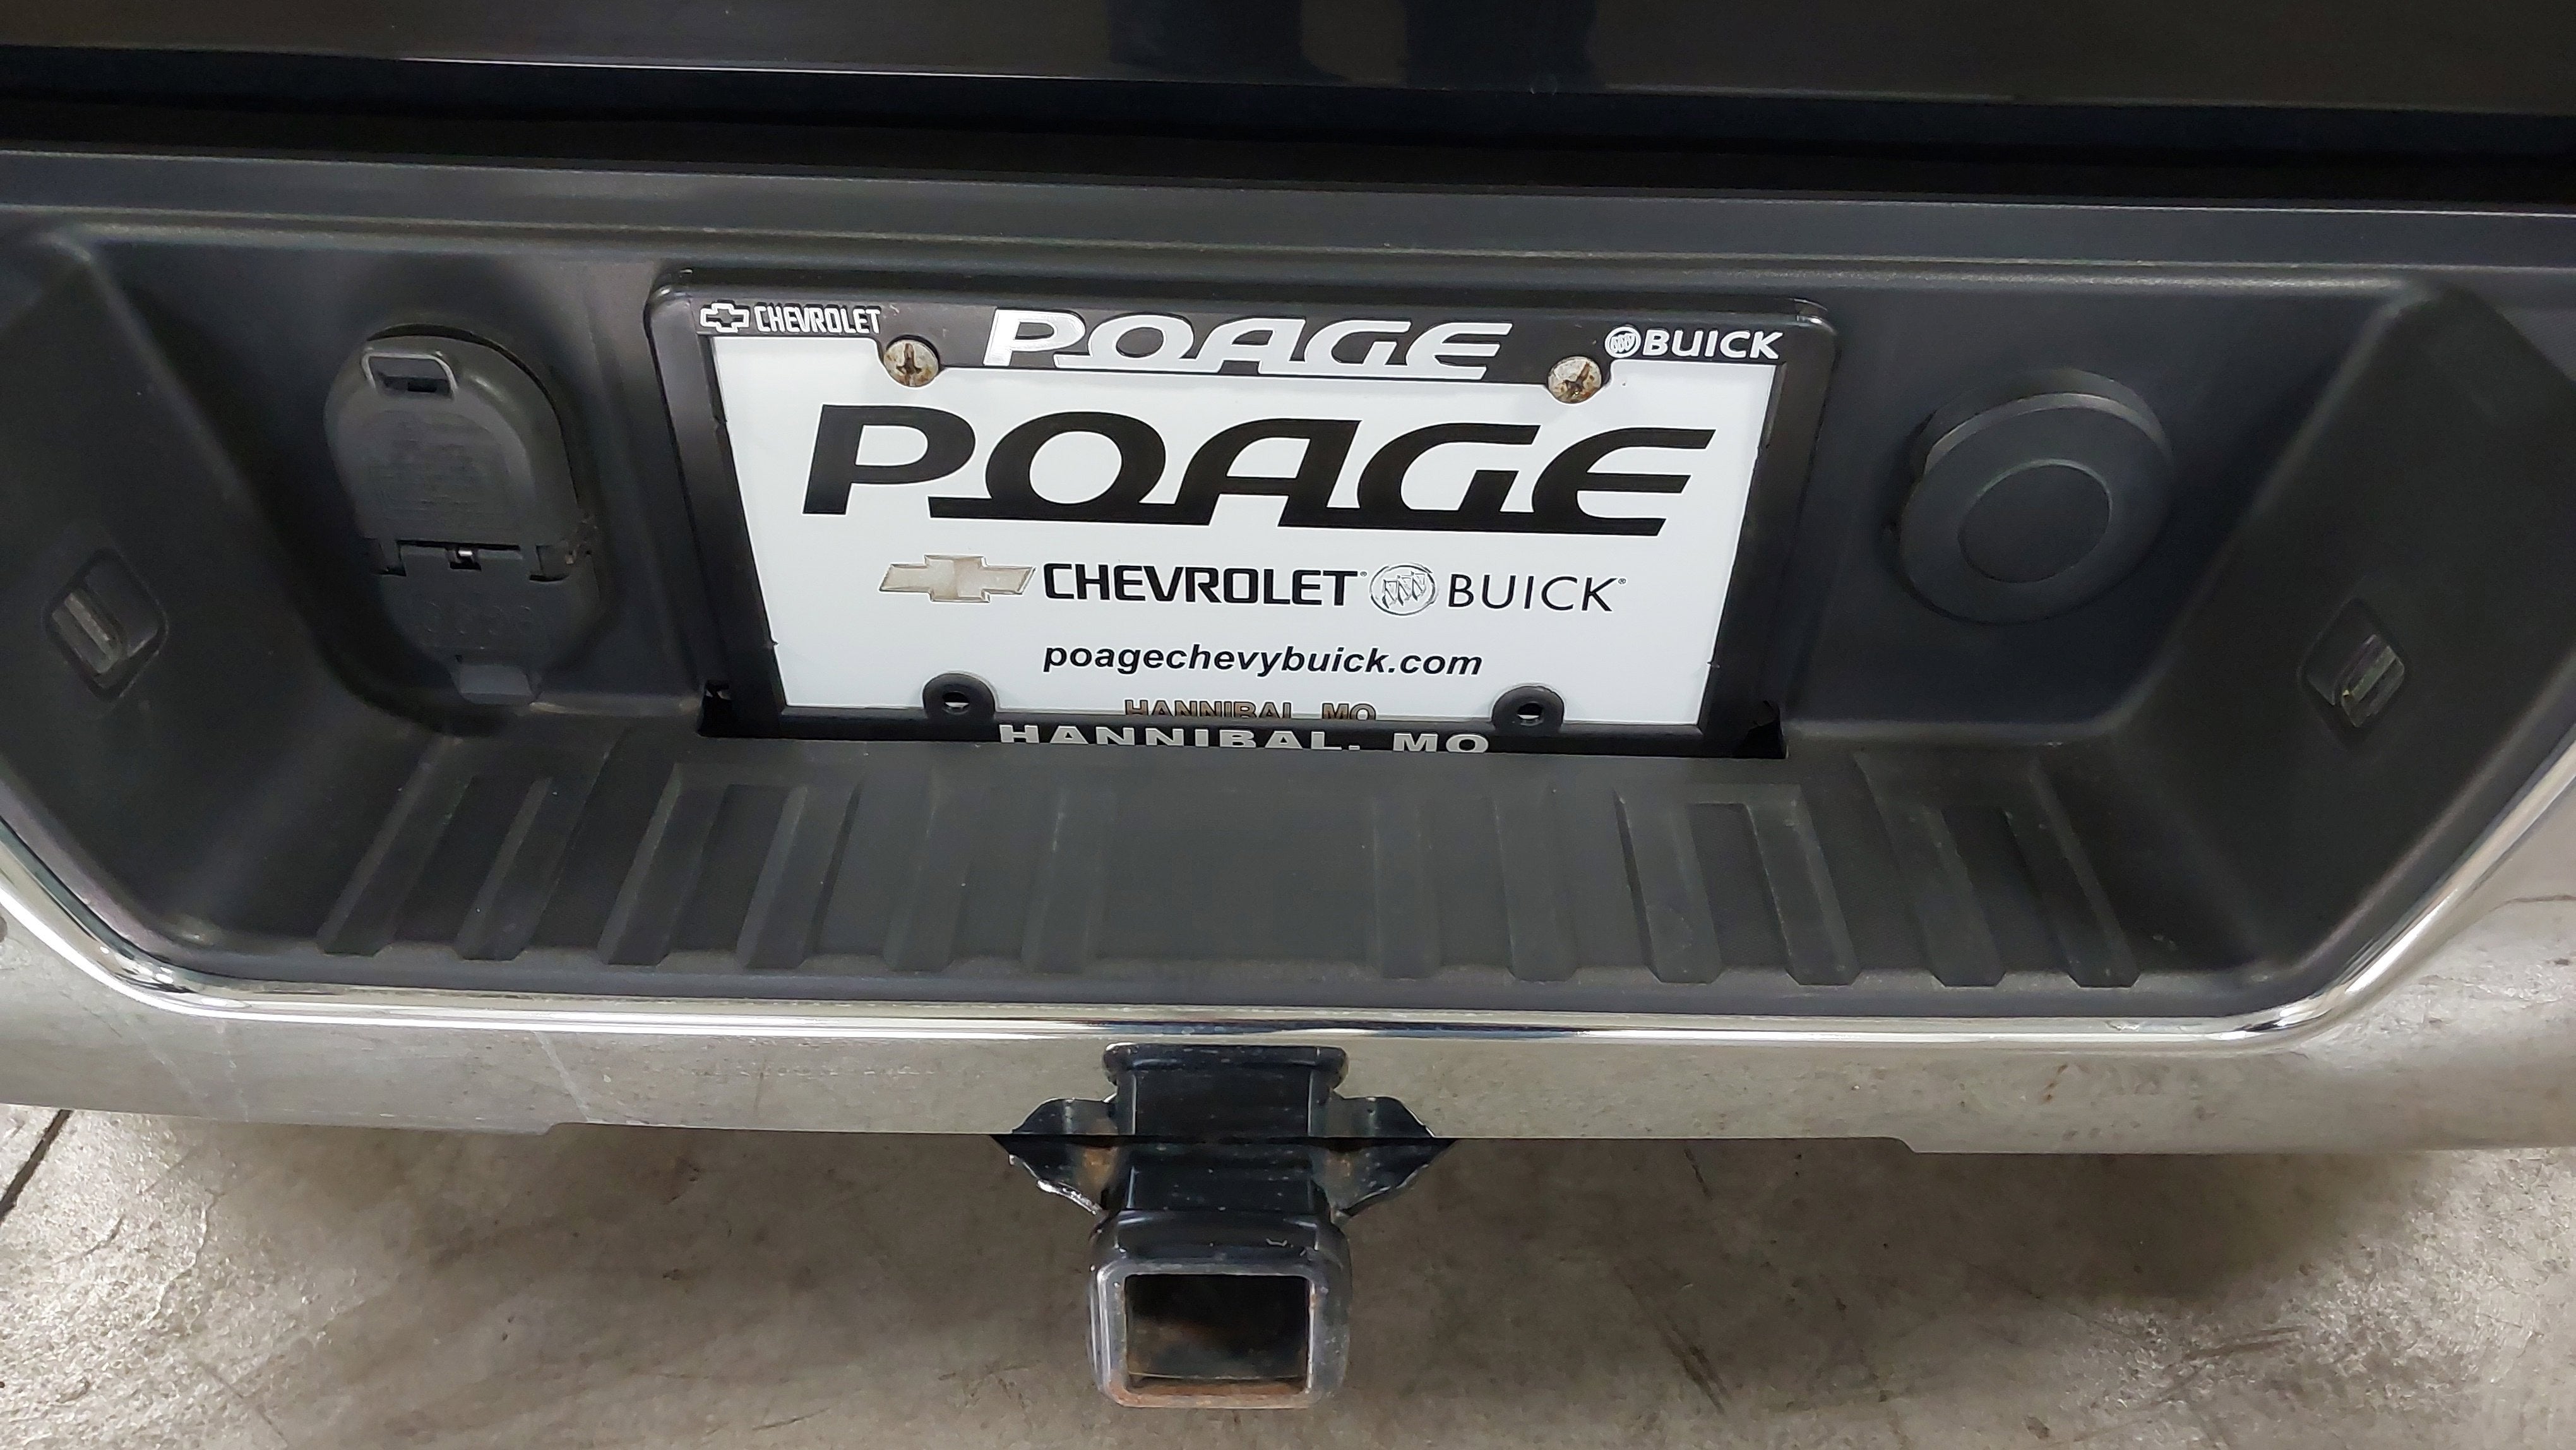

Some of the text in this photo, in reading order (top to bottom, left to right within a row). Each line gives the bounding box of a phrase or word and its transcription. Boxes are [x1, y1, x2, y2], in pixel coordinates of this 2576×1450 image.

[756, 305, 881, 334] CHEVROLET
[982, 308, 1513, 381] POAGE
[1642, 329, 1784, 359] BUICK
[802, 405, 1716, 536] POAGE
[1043, 644, 1482, 678] poagechevybuick.com
[1322, 703, 1377, 721] MO
[1392, 733, 1489, 753] MO
